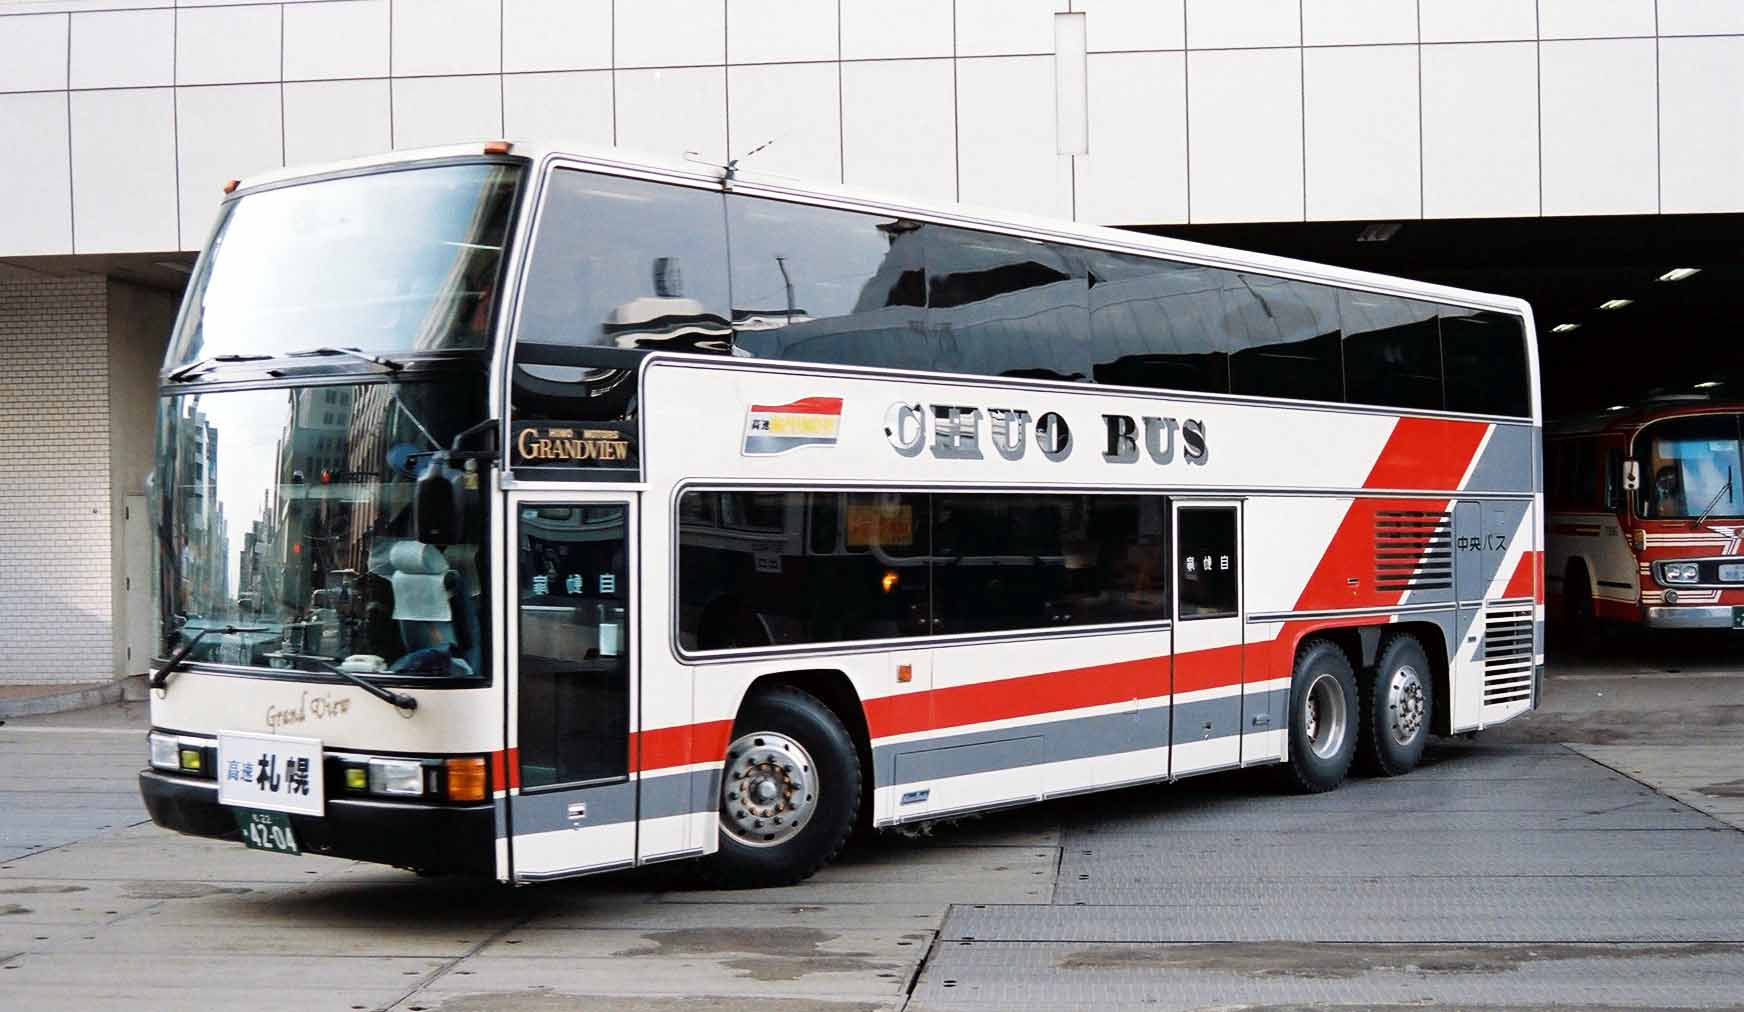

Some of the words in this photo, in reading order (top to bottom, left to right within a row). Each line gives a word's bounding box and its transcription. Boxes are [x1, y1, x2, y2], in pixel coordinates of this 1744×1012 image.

[884, 401, 1073, 462] CHUO
[1102, 413, 1208, 465] BUS
[1457, 534, 1506, 552] 中央バス
[226, 759, 256, 783] 高速
[256, 753, 310, 796] 札幌
